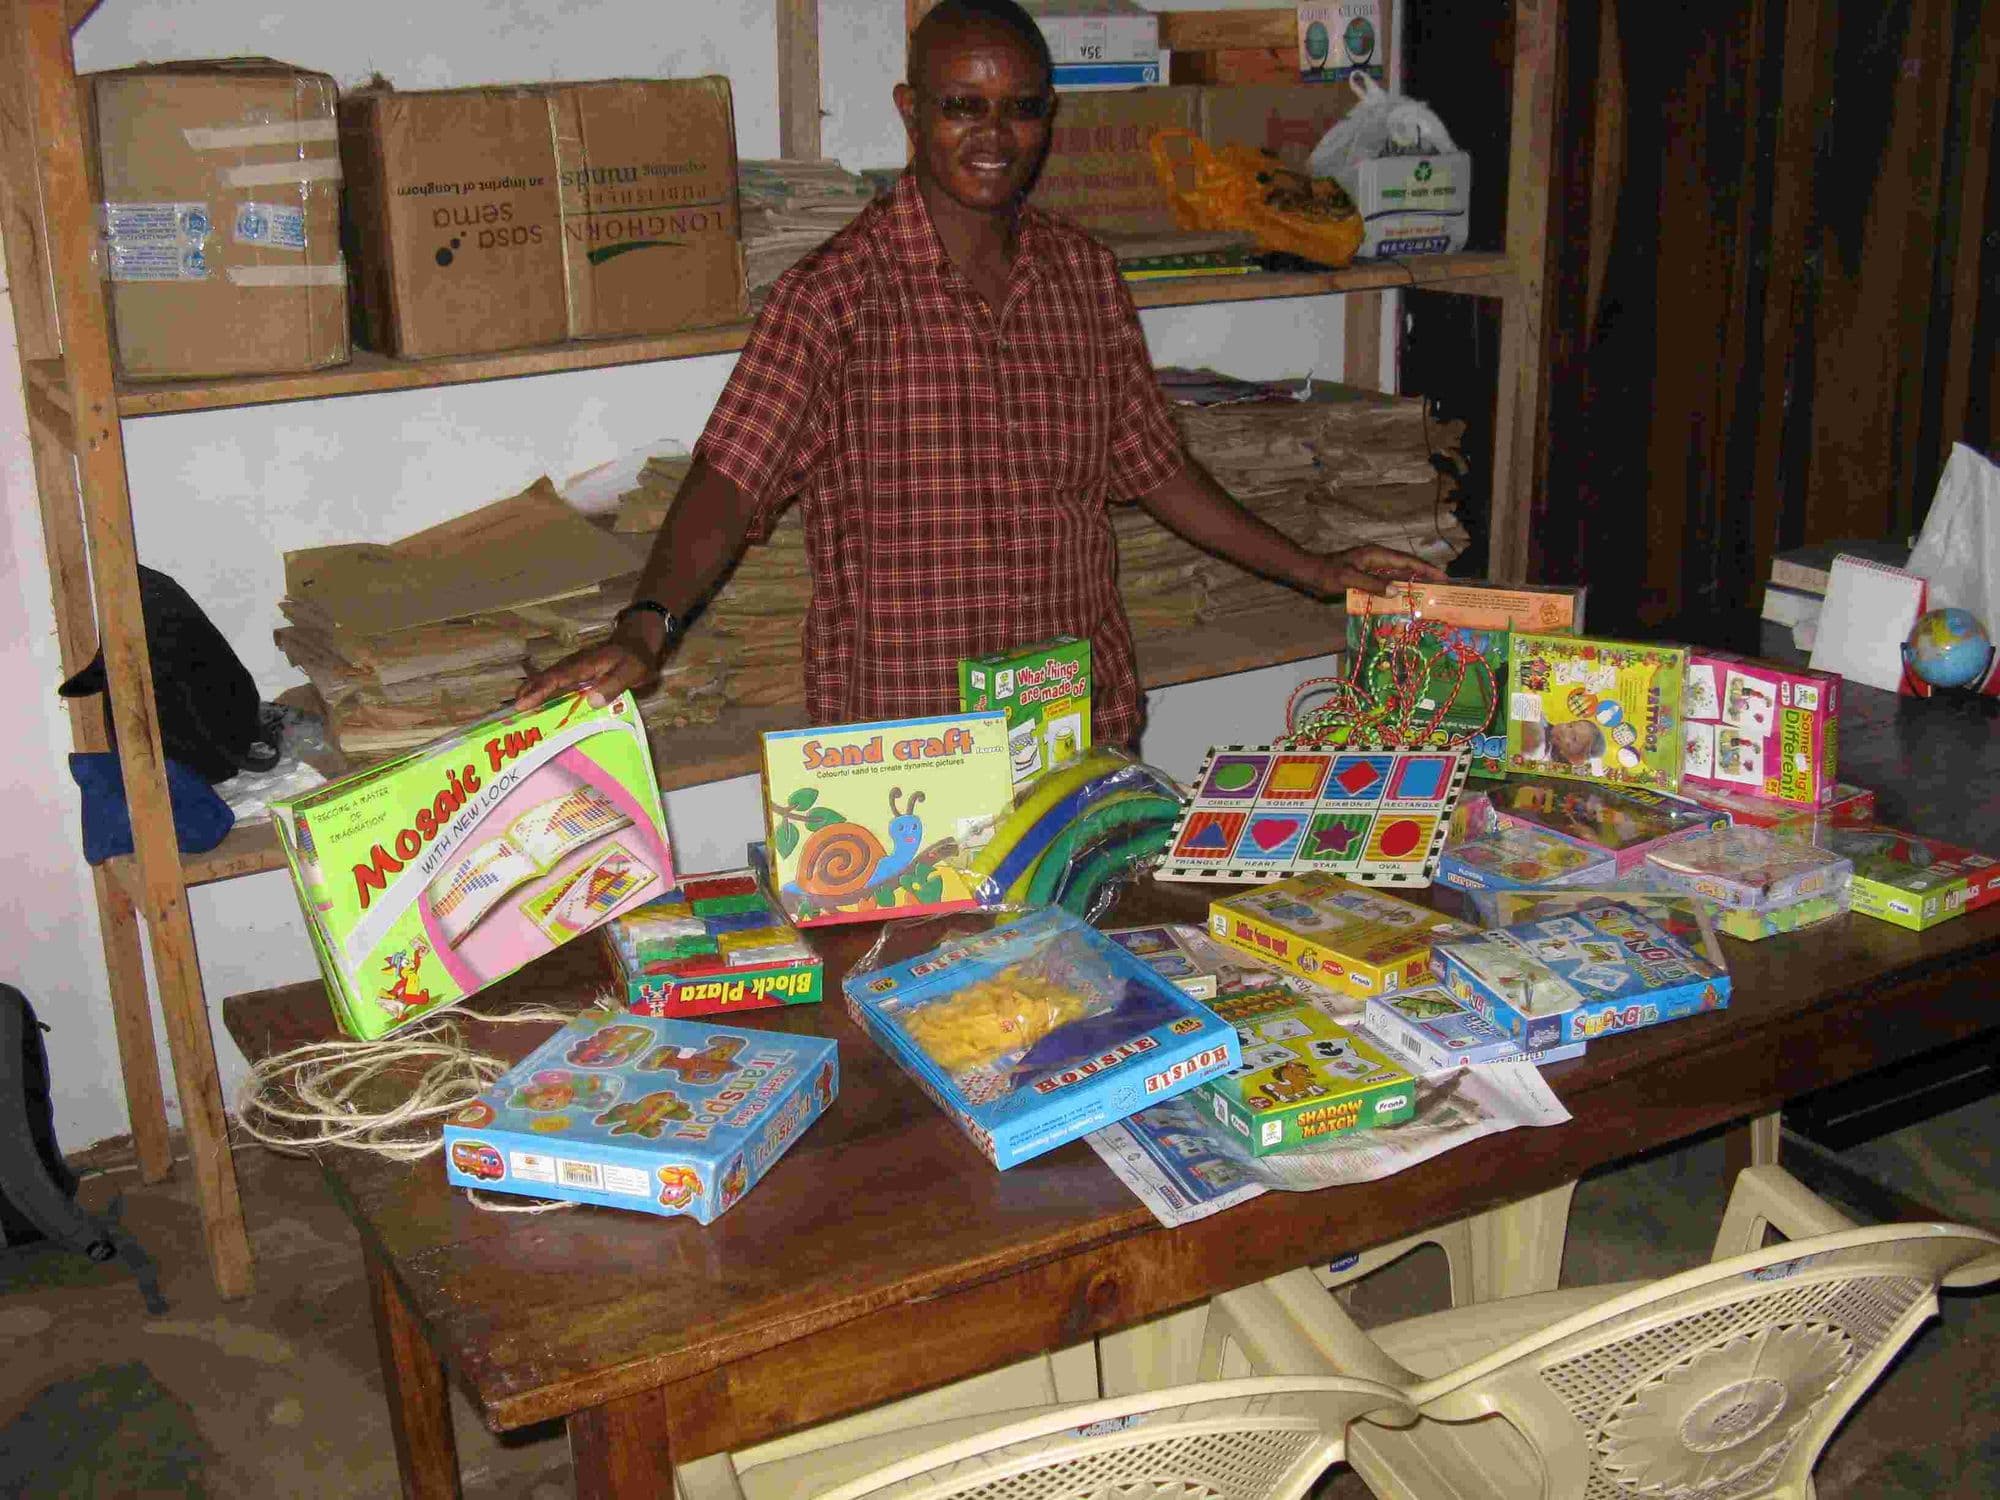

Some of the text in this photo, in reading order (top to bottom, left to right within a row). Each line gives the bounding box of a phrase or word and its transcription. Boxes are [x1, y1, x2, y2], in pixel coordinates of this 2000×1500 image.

[1081, 46, 1102, 59] 35A
[397, 176, 544, 197] an imprint of Longhorn
[561, 167, 637, 192] minds
[433, 203, 513, 229] sema
[564, 211, 723, 241] LONGHORN
[478, 225, 542, 249] sasa
[1017, 666, 1046, 687] What
[1046, 659, 1079, 681] Things
[1020, 677, 1086, 705] are made of
[803, 728, 976, 770] Sand craft
[1780, 709, 1801, 799] Different!
[816, 758, 965, 779] Colourful sand to create dynamic pictures
[1207, 799, 1242, 807] CIRCLE
[1383, 801, 1441, 809] RECTANGLE
[352, 727, 544, 909] Mosaic Fun
[421, 768, 521, 874] WITH NEW LOOK
[680, 971, 813, 1005] Block Plaza
[1033, 1036, 1159, 1094] HOUSIE
[1145, 1045, 1228, 1094] HOUSIE
[674, 1049, 797, 1140] Transport
[1378, 1098, 1406, 1111] Frank
[1297, 1099, 1364, 1127] SHADOW
[1302, 1114, 1358, 1140] MATCH
